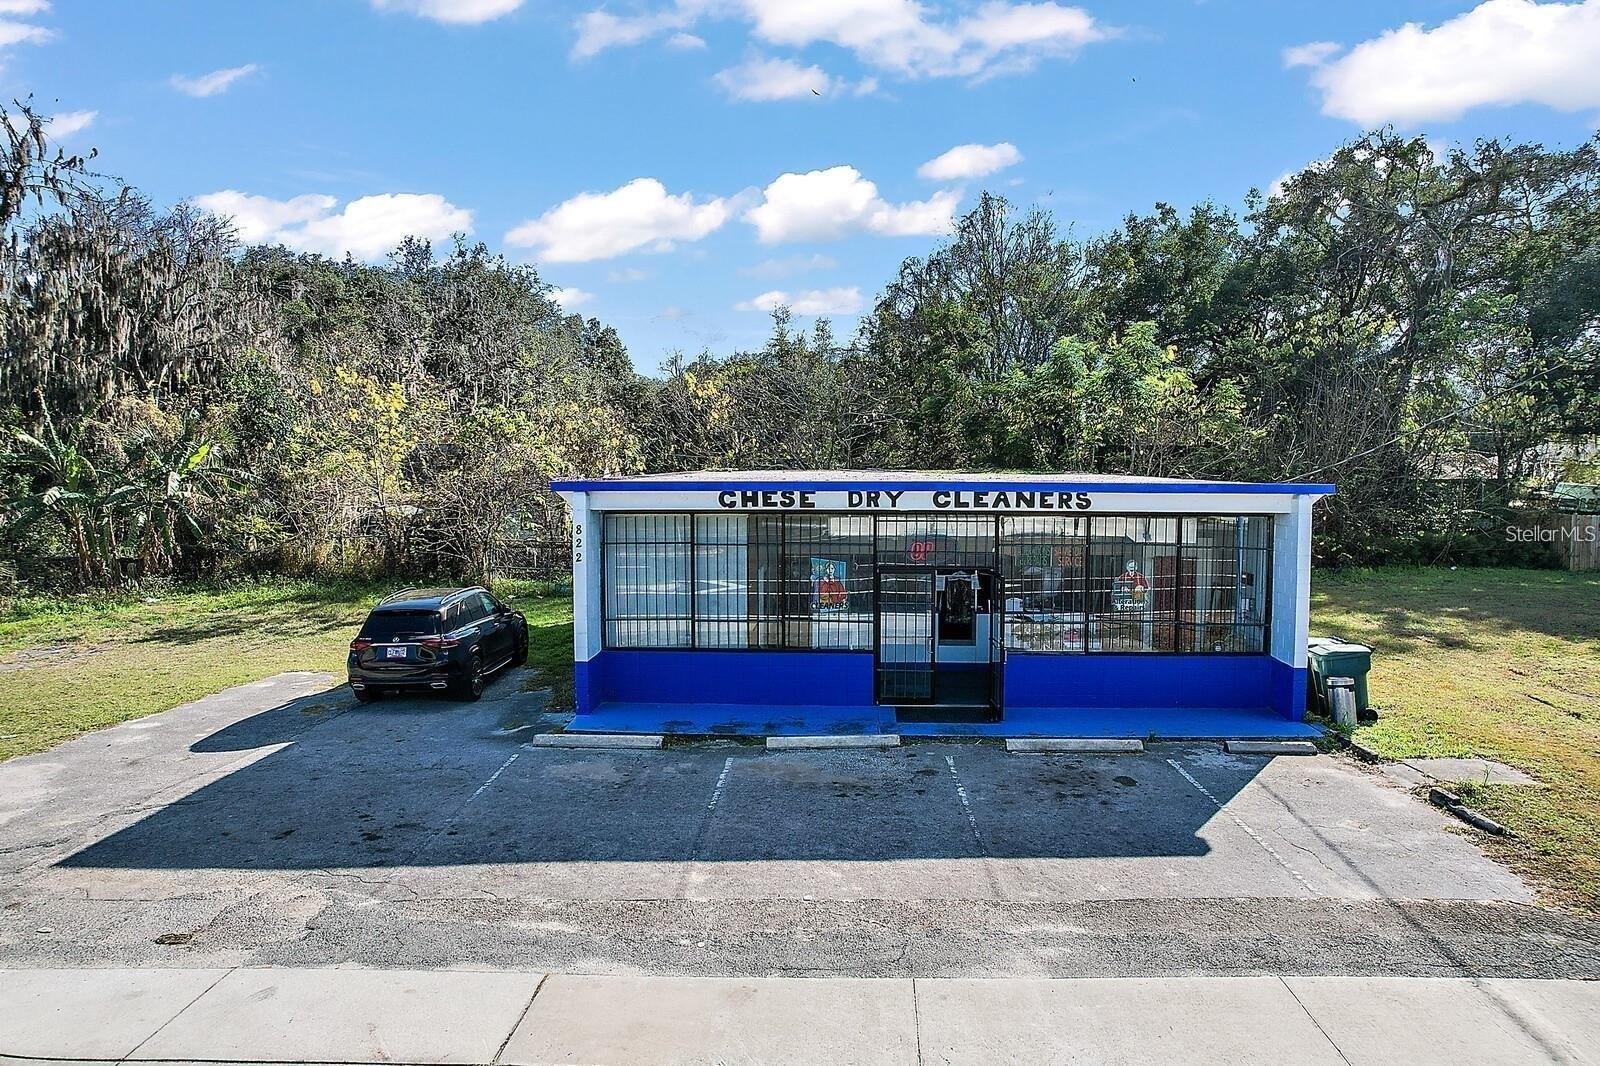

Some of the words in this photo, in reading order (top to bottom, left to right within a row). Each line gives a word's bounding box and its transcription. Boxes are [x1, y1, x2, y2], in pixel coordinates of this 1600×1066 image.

[718, 491, 816, 508] CHESE
[848, 491, 905, 508] DRY
[933, 491, 1092, 509] CLEANERS
